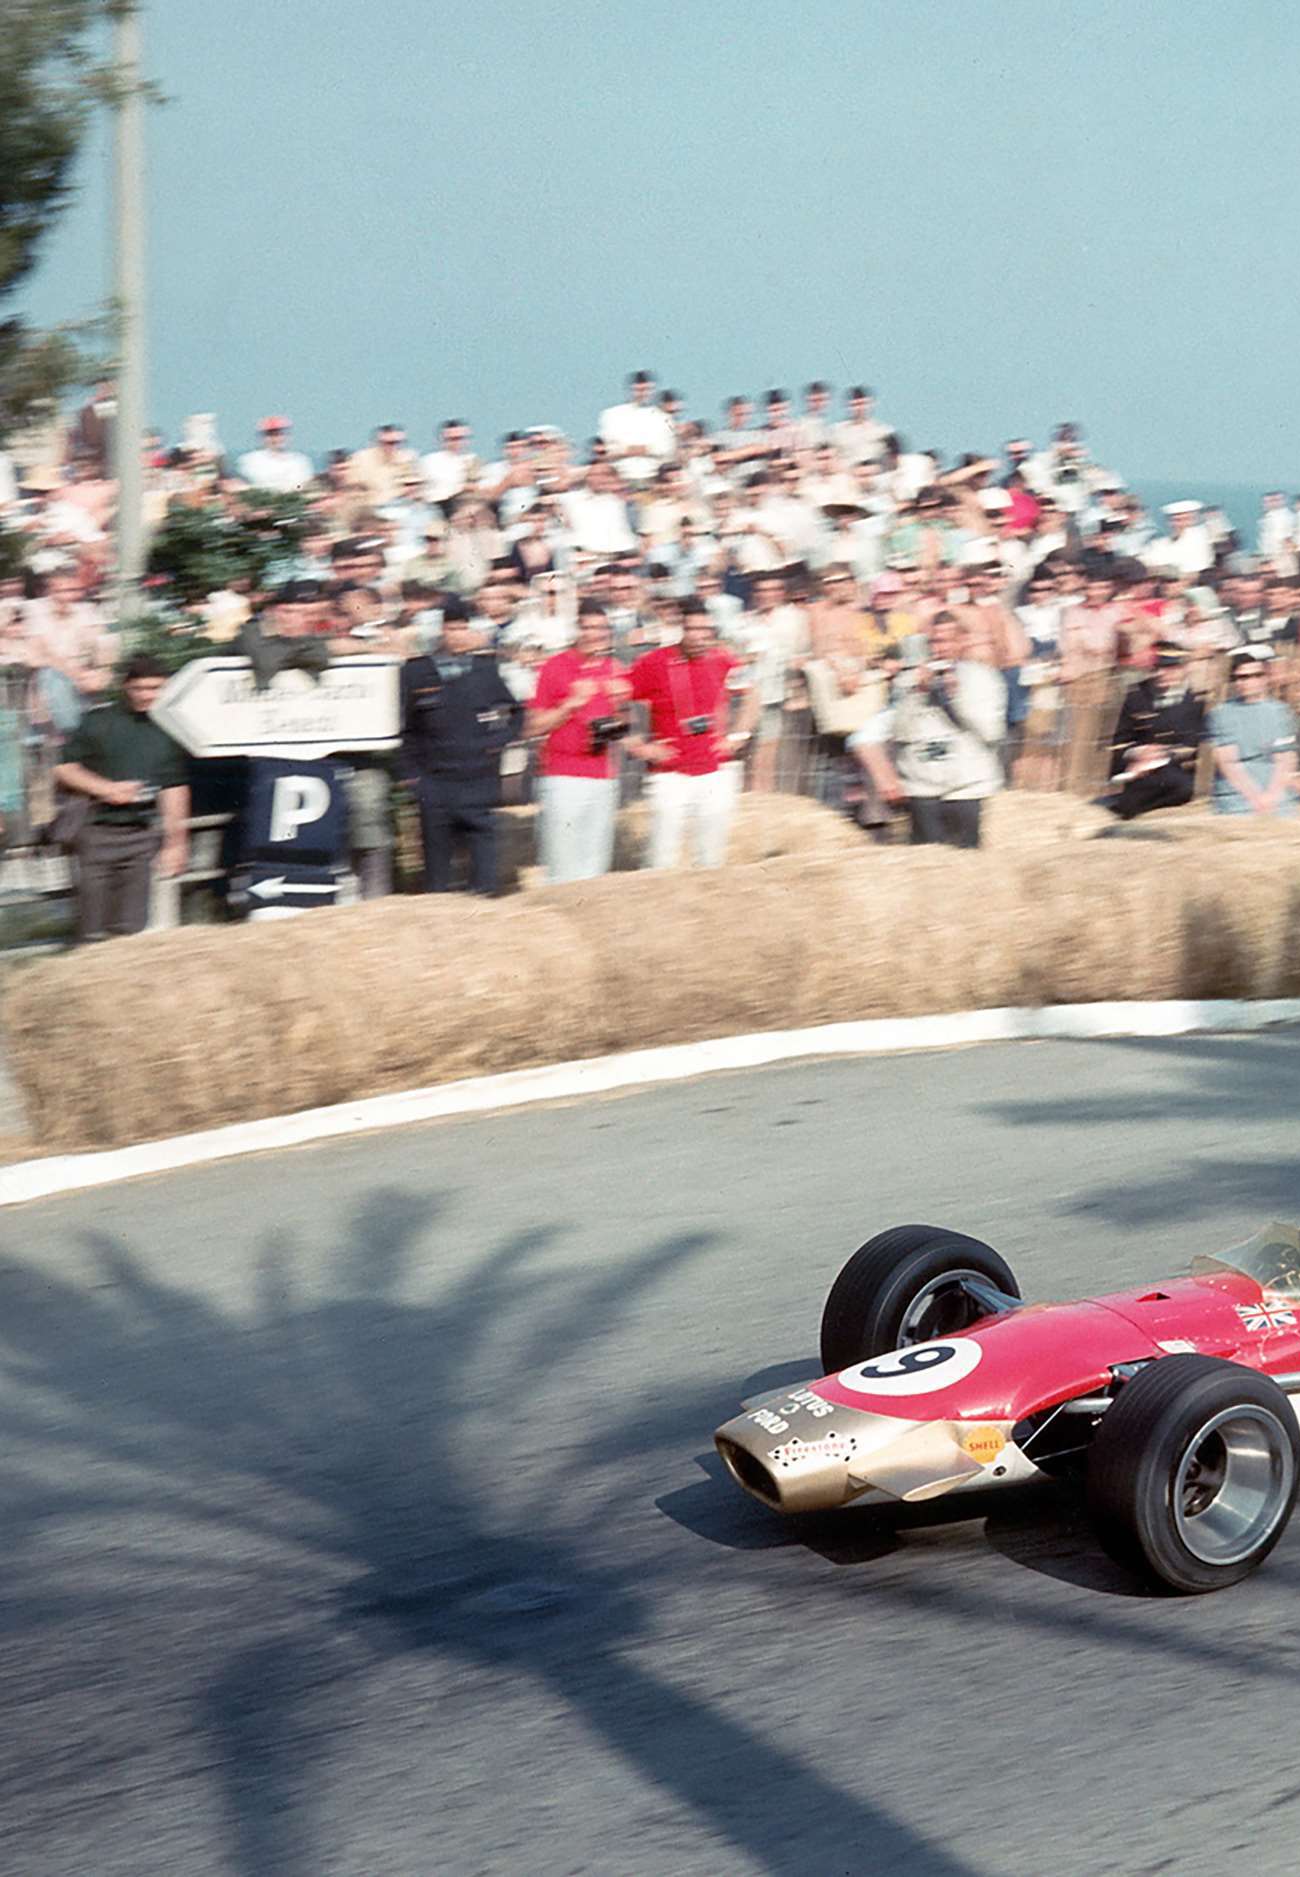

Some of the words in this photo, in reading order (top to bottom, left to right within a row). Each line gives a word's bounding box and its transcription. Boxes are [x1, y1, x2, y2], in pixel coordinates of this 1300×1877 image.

[269, 775, 331, 842] P
[860, 1346, 956, 1379] 9
[788, 1388, 834, 1417] LOTUS
[747, 1408, 790, 1434] FORD
[969, 1439, 999, 1452] SHELL
